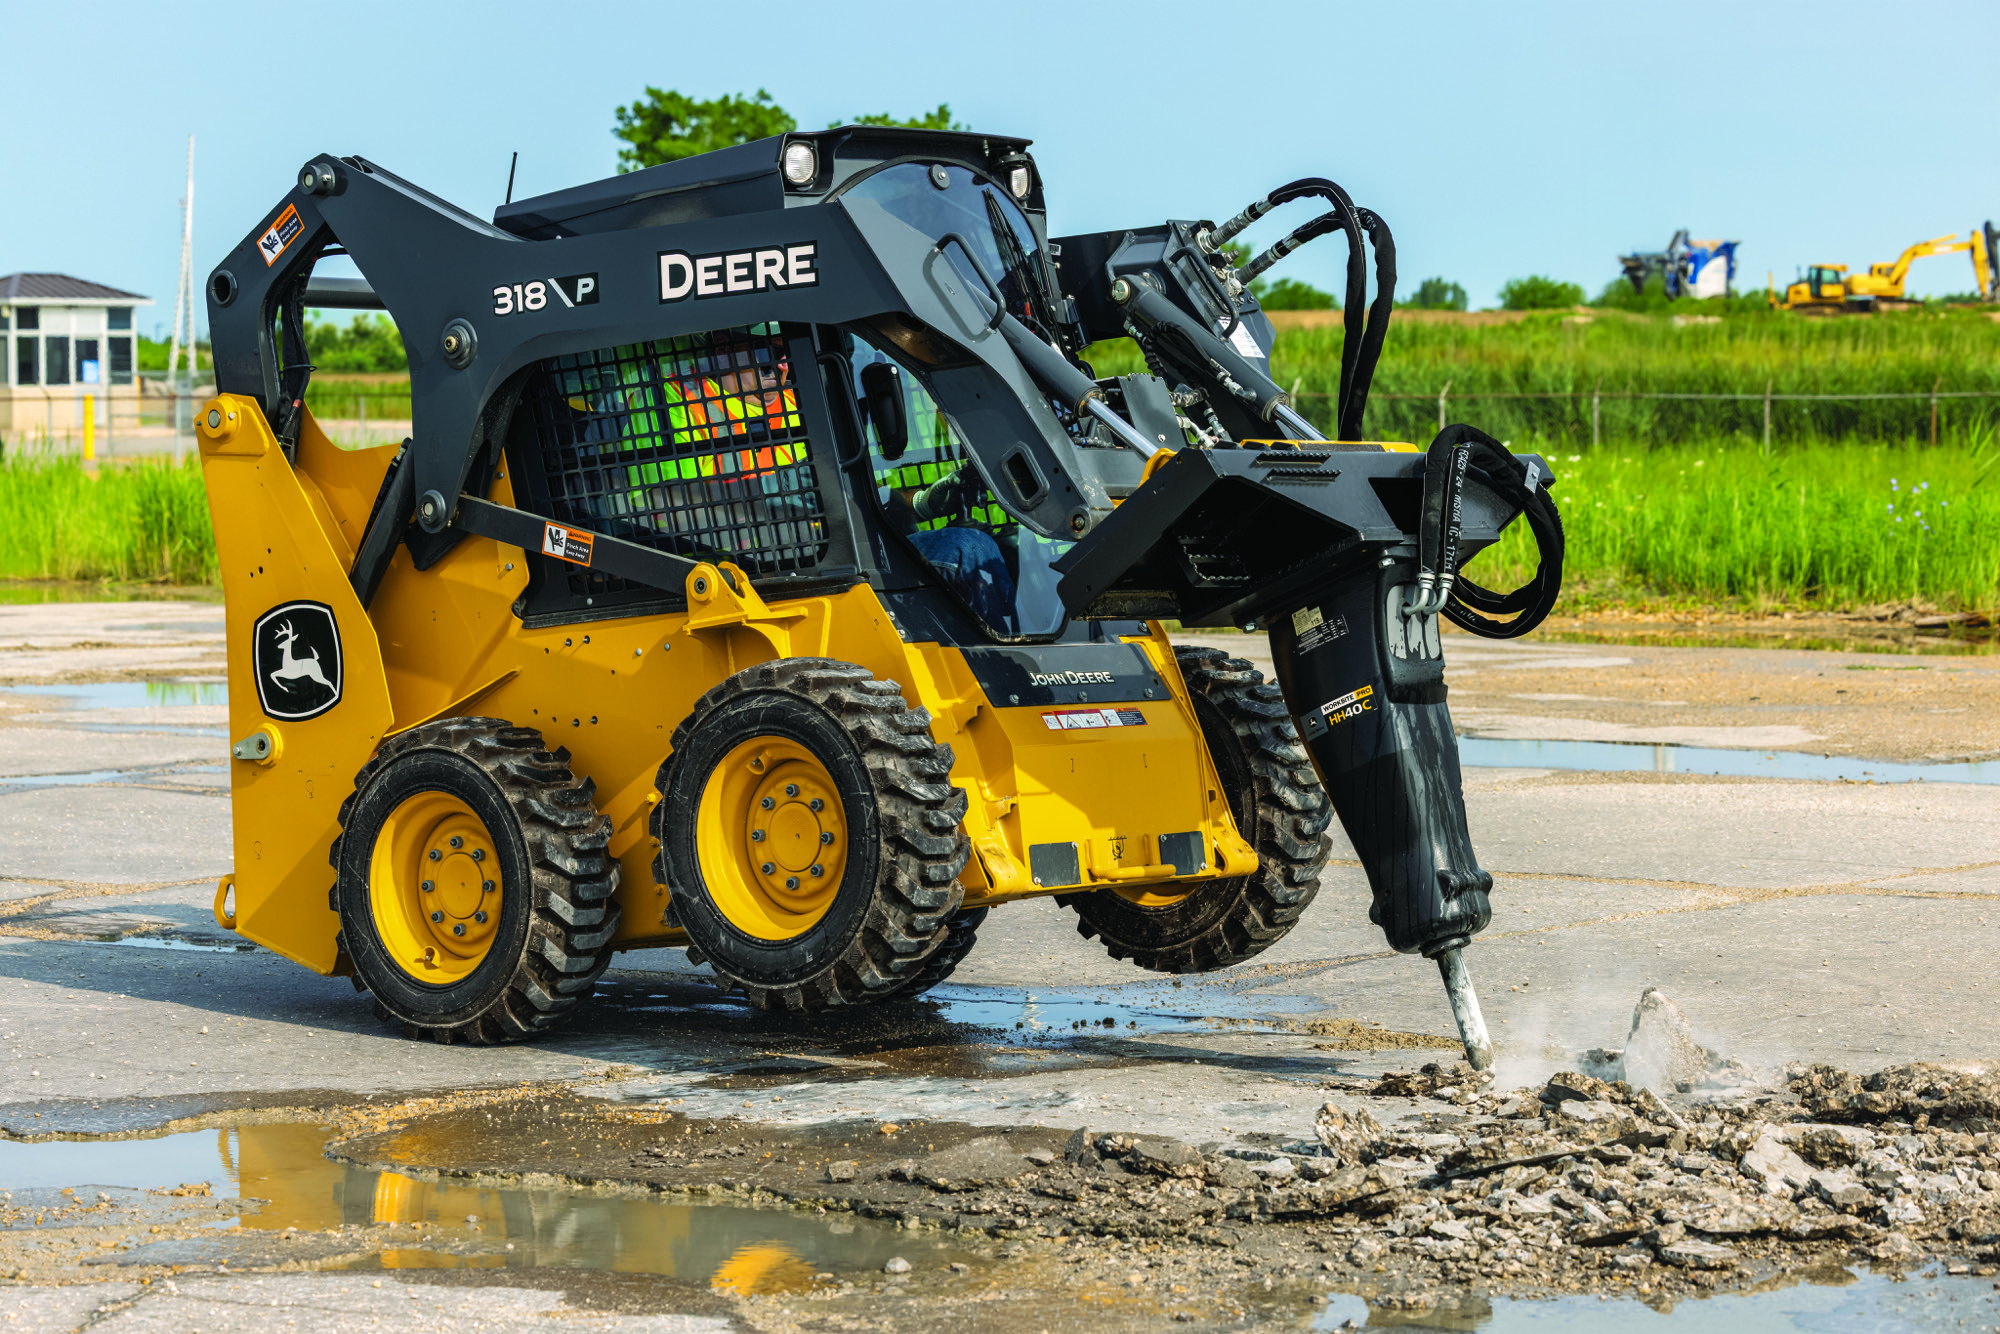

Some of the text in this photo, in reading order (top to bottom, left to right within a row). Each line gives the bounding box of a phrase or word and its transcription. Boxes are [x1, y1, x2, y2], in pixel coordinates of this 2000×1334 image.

[660, 245, 817, 300] DEERE
[493, 281, 547, 315] 318
[1452, 494, 1463, 522] MSHA
[1448, 526, 1459, 537] IC
[578, 546, 589, 554] Area
[1029, 670, 1115, 687] JOHN DEERE
[1322, 687, 1371, 712] WORKSITE PRO
[1328, 699, 1372, 726] HH40C
